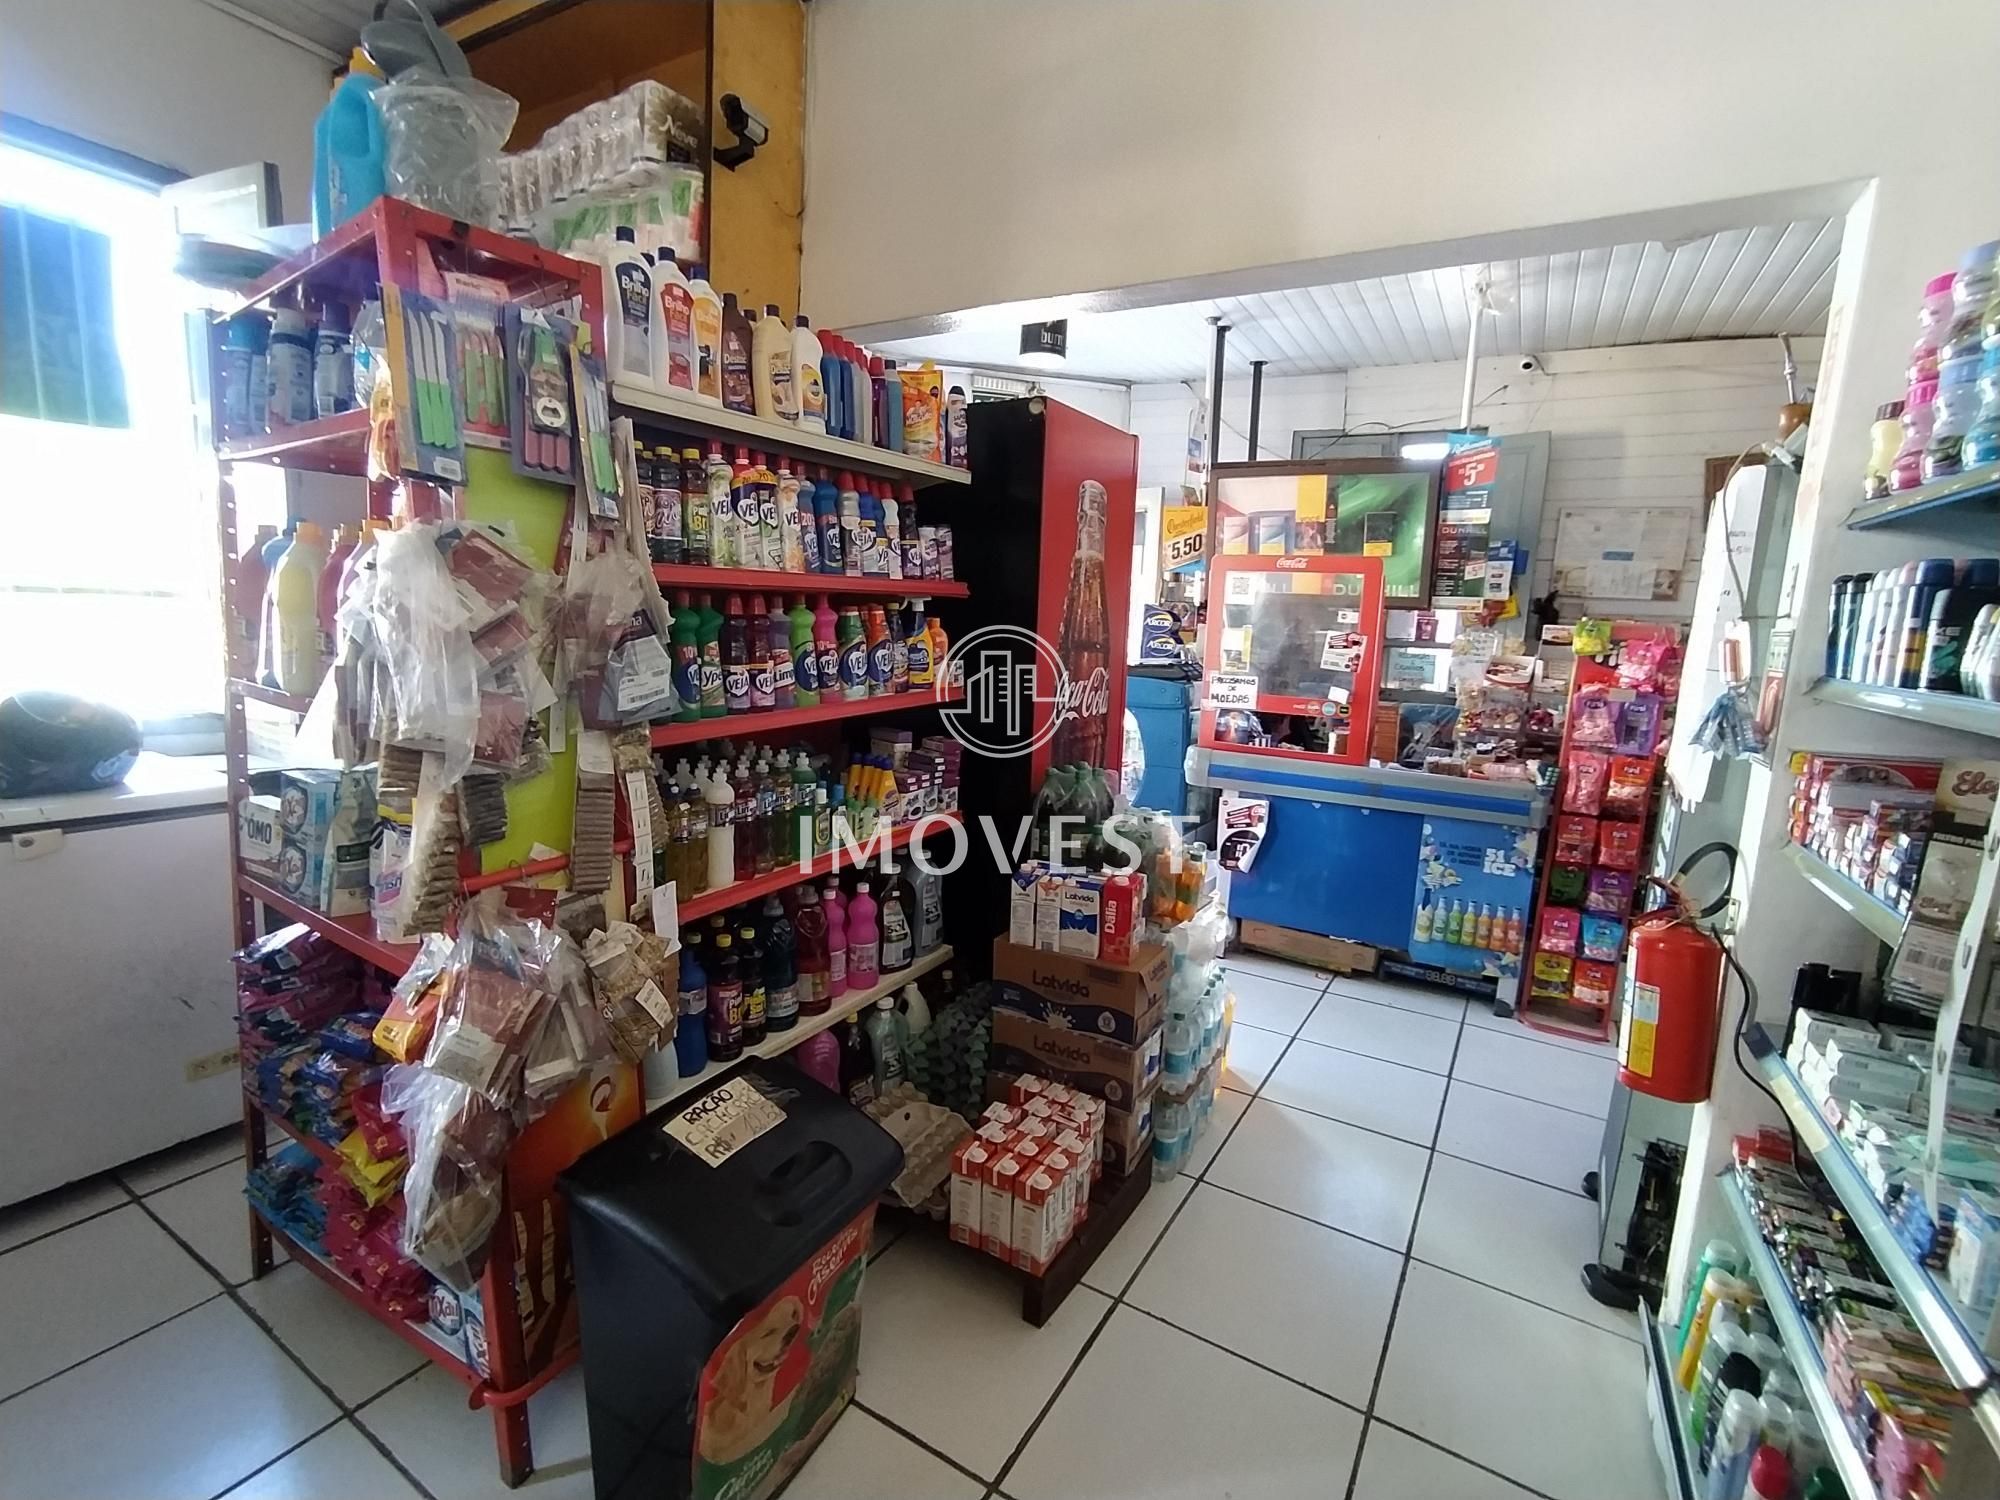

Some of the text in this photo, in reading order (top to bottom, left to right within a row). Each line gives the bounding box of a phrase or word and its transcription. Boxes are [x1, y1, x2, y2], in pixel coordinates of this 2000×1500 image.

[658, 114, 699, 148] Neve
[621, 274, 649, 297] Brilho
[665, 296, 690, 315] Brilho
[1211, 693, 1250, 704] MOEDAS
[247, 819, 273, 845] OMO
[1484, 848, 1506, 862] 51
[1483, 861, 1517, 878] ICE
[1065, 891, 1095, 903] Latvida
[1032, 969, 1090, 999] Latvida
[1034, 1034, 1090, 1065] Latvida
